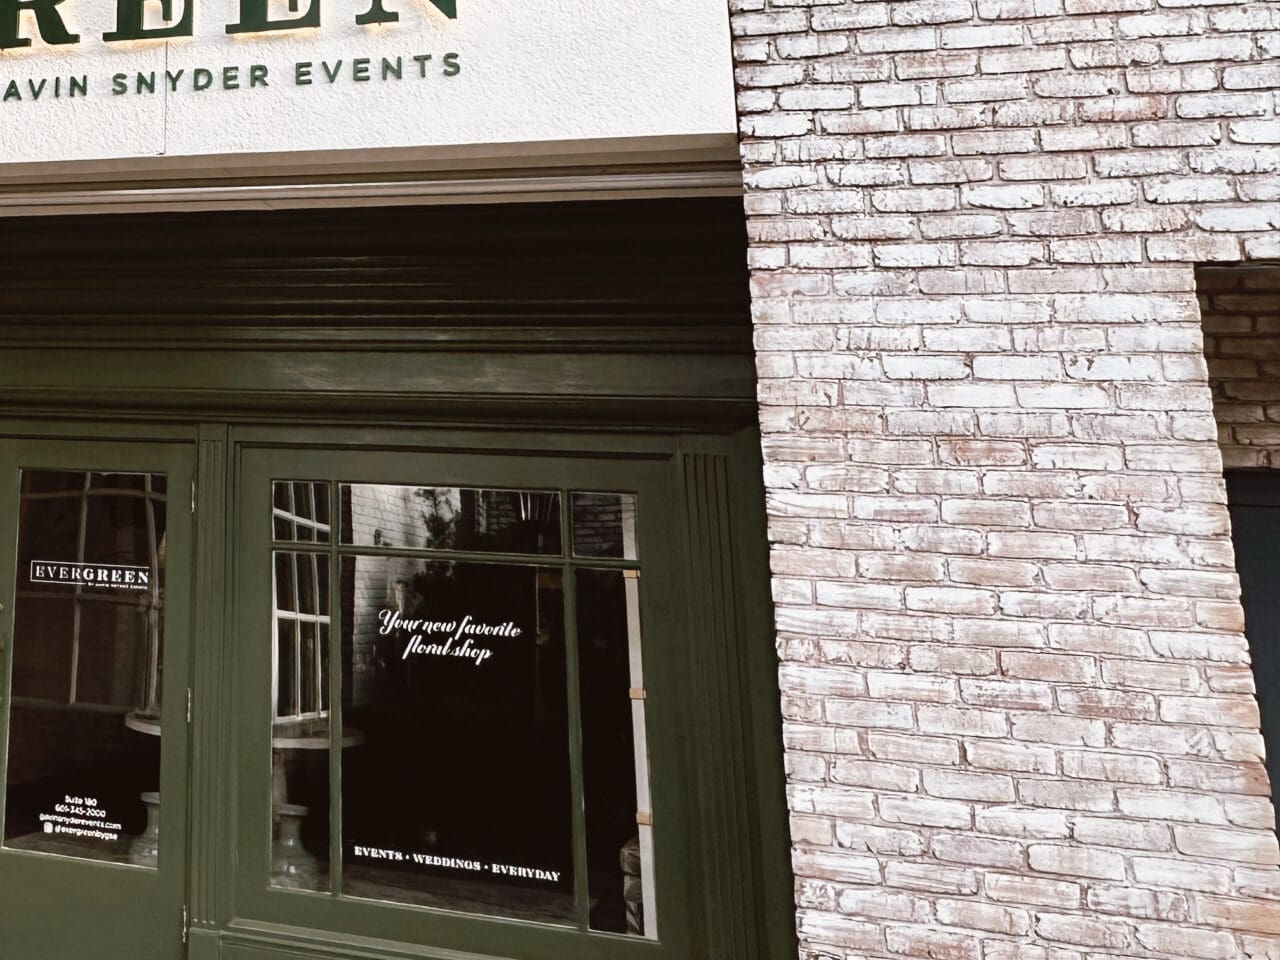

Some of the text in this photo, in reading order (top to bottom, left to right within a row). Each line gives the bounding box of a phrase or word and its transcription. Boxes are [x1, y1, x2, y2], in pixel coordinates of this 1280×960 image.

[111, 63, 269, 94] SNYDER
[293, 52, 463, 87] EVENTS
[36, 565, 148, 584] EVERGREEN
[378, 609, 521, 640] Your new favorite
[402, 634, 493, 666] floral shop
[354, 846, 560, 882] EVENTS WEDDINGS EVERYDAY
